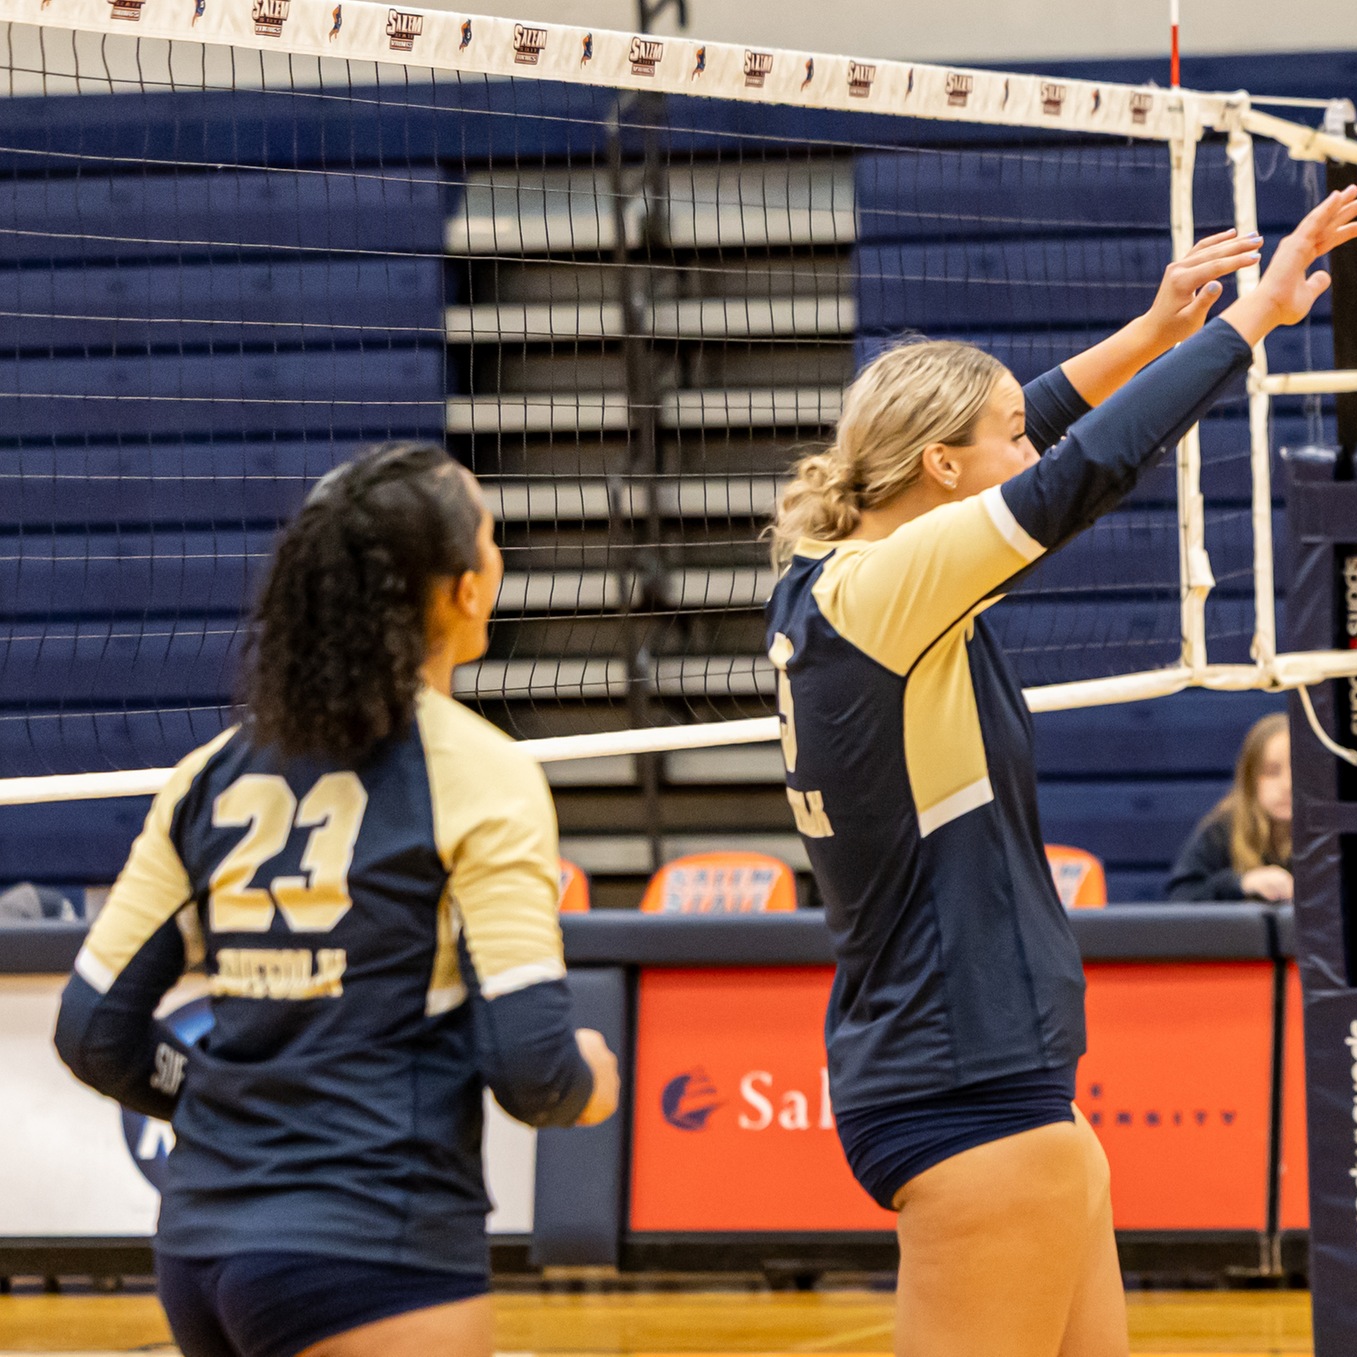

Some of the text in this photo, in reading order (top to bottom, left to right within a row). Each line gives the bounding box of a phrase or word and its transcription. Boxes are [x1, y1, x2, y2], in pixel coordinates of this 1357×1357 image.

[386, 8, 423, 35] SALEM
[514, 23, 547, 49] SALEM
[209, 770, 369, 933] 23
